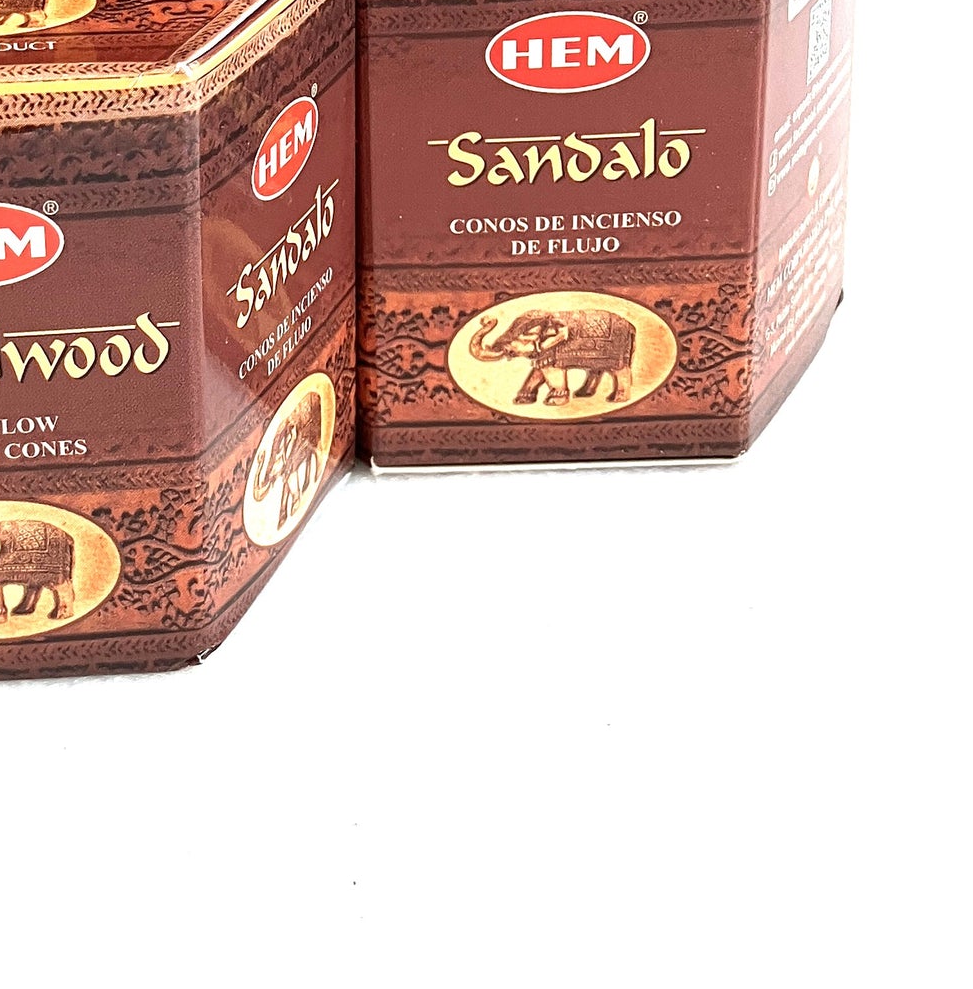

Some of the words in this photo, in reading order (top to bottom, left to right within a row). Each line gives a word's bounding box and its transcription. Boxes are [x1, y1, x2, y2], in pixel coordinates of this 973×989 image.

[502, 34, 634, 70] HEM
[259, 109, 313, 188] HEM
[444, 118, 693, 187] Sandalo
[449, 217, 529, 234] CONOS
[535, 215, 564, 232] DE
[571, 210, 682, 230] INCIENSO
[511, 239, 540, 255] DE
[547, 236, 620, 254] FLUJO
[235, 184, 335, 329] Sandalo
[239, 331, 275, 380] CONOS
[276, 314, 290, 339] DE
[291, 267, 333, 320] INCIENSO
[267, 352, 281, 376] DE
[282, 316, 312, 356] FLUJO
[4, 439, 87, 459] CONES
